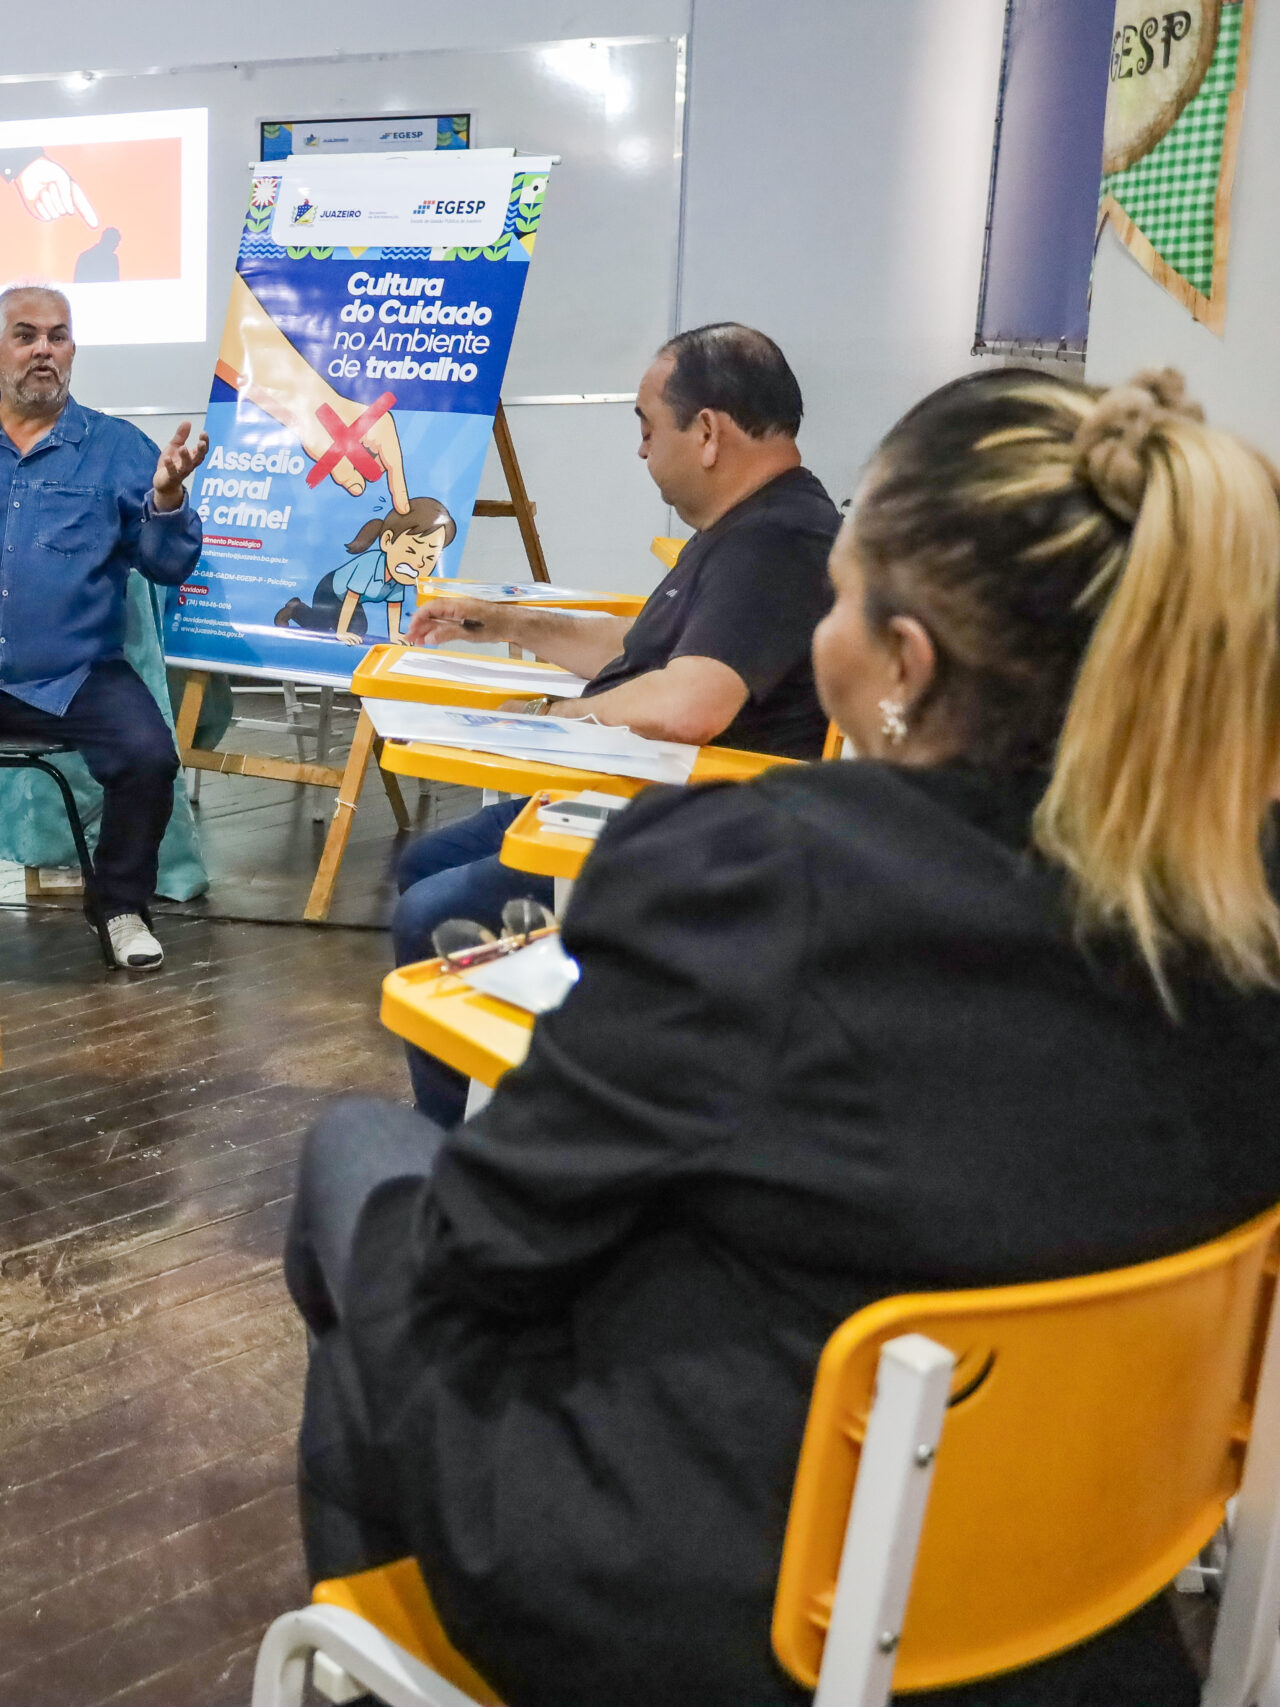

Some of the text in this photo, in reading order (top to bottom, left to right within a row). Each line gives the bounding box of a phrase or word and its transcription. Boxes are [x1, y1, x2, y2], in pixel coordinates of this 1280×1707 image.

[1111, 10, 1192, 82] GESP
[393, 131, 423, 139] EGESP
[320, 210, 362, 218] JUAZEIRO
[435, 200, 486, 215] EGESP
[347, 271, 445, 297] Cultura
[340, 299, 493, 326] do Cuidado
[333, 327, 491, 355] no Ambiente
[328, 354, 478, 383] de trabalho
[207, 445, 305, 475] Assédio
[201, 476, 273, 501] moral
[196, 497, 292, 530] é crime!
[202, 536, 262, 549] dimento Psicológico
[201, 549, 289, 564] colhimento@juazeiro.ba.gov.br
[180, 585, 208, 594] Ouvidoria
[192, 570, 263, 583] D-GAB-GADM-EGESP-P
[267, 577, 297, 587] Psicólogo
